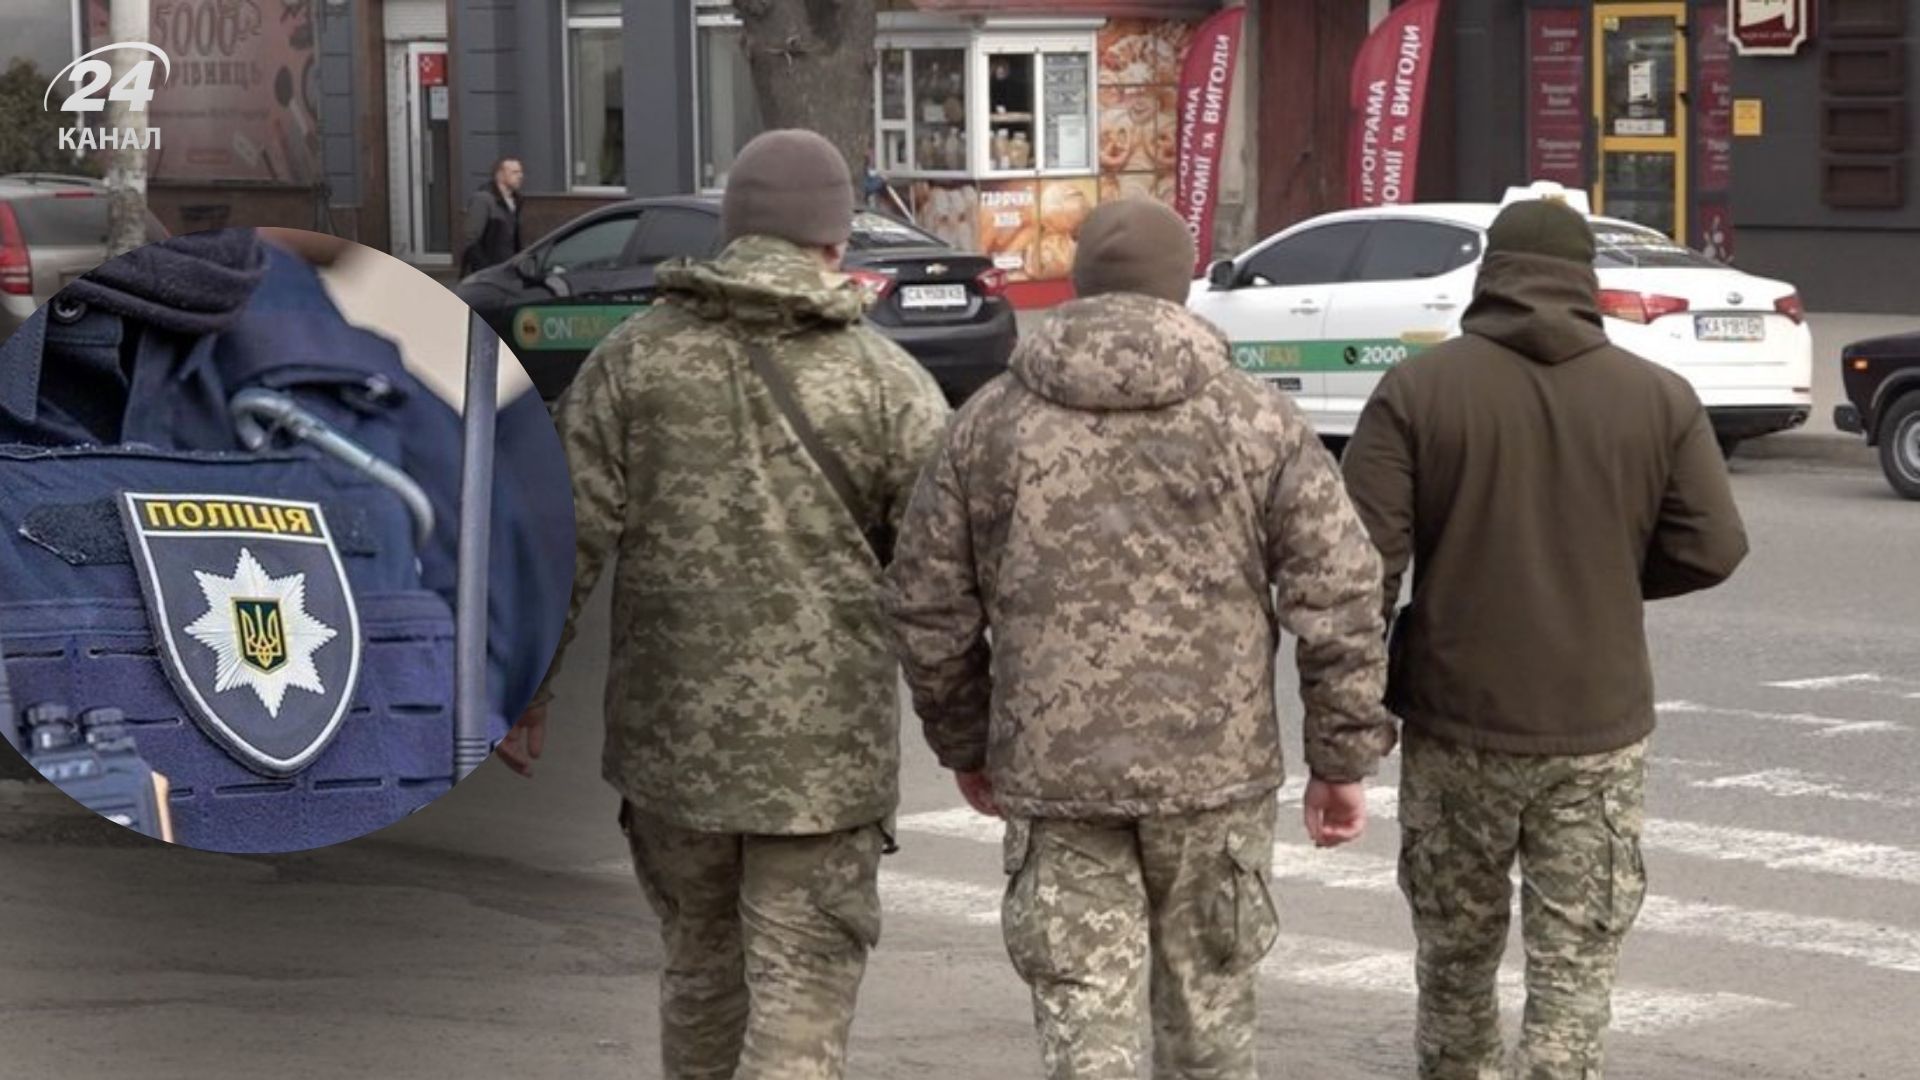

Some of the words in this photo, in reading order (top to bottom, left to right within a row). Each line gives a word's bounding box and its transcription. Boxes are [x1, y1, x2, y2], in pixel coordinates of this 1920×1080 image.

[1203, 34, 1231, 125] ВИГОДИ
[1391, 24, 1421, 117] ВИГОДИ
[1381, 148, 1405, 206] ОМІЇ
[144, 500, 314, 534] ПОЛІЦІЯ
